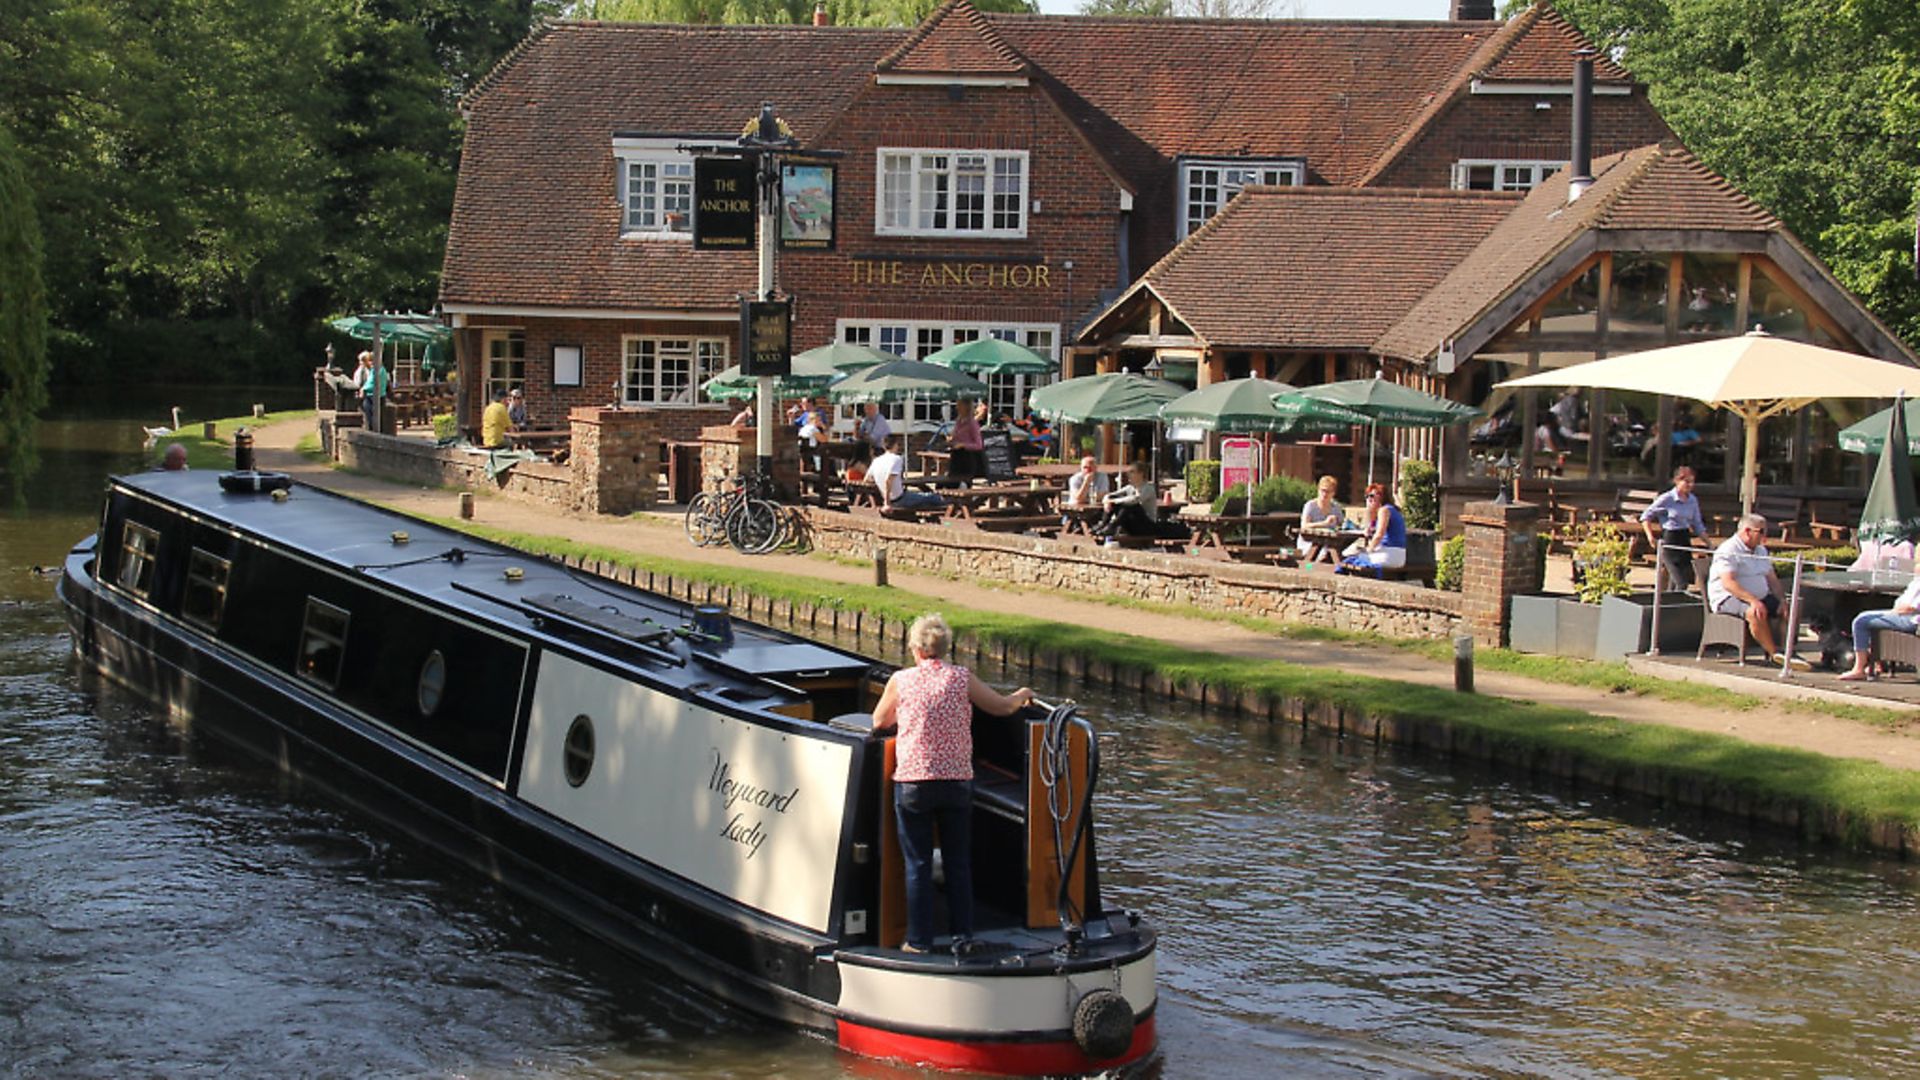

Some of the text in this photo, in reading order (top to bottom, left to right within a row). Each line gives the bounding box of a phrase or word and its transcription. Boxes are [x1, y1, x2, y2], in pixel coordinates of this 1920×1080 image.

[714, 179, 737, 192] THE
[700, 200, 751, 213] ANCHOR
[850, 261, 1051, 288] THE ANCHOR
[709, 747, 800, 814] Weyward
[719, 812, 768, 860] Lady
